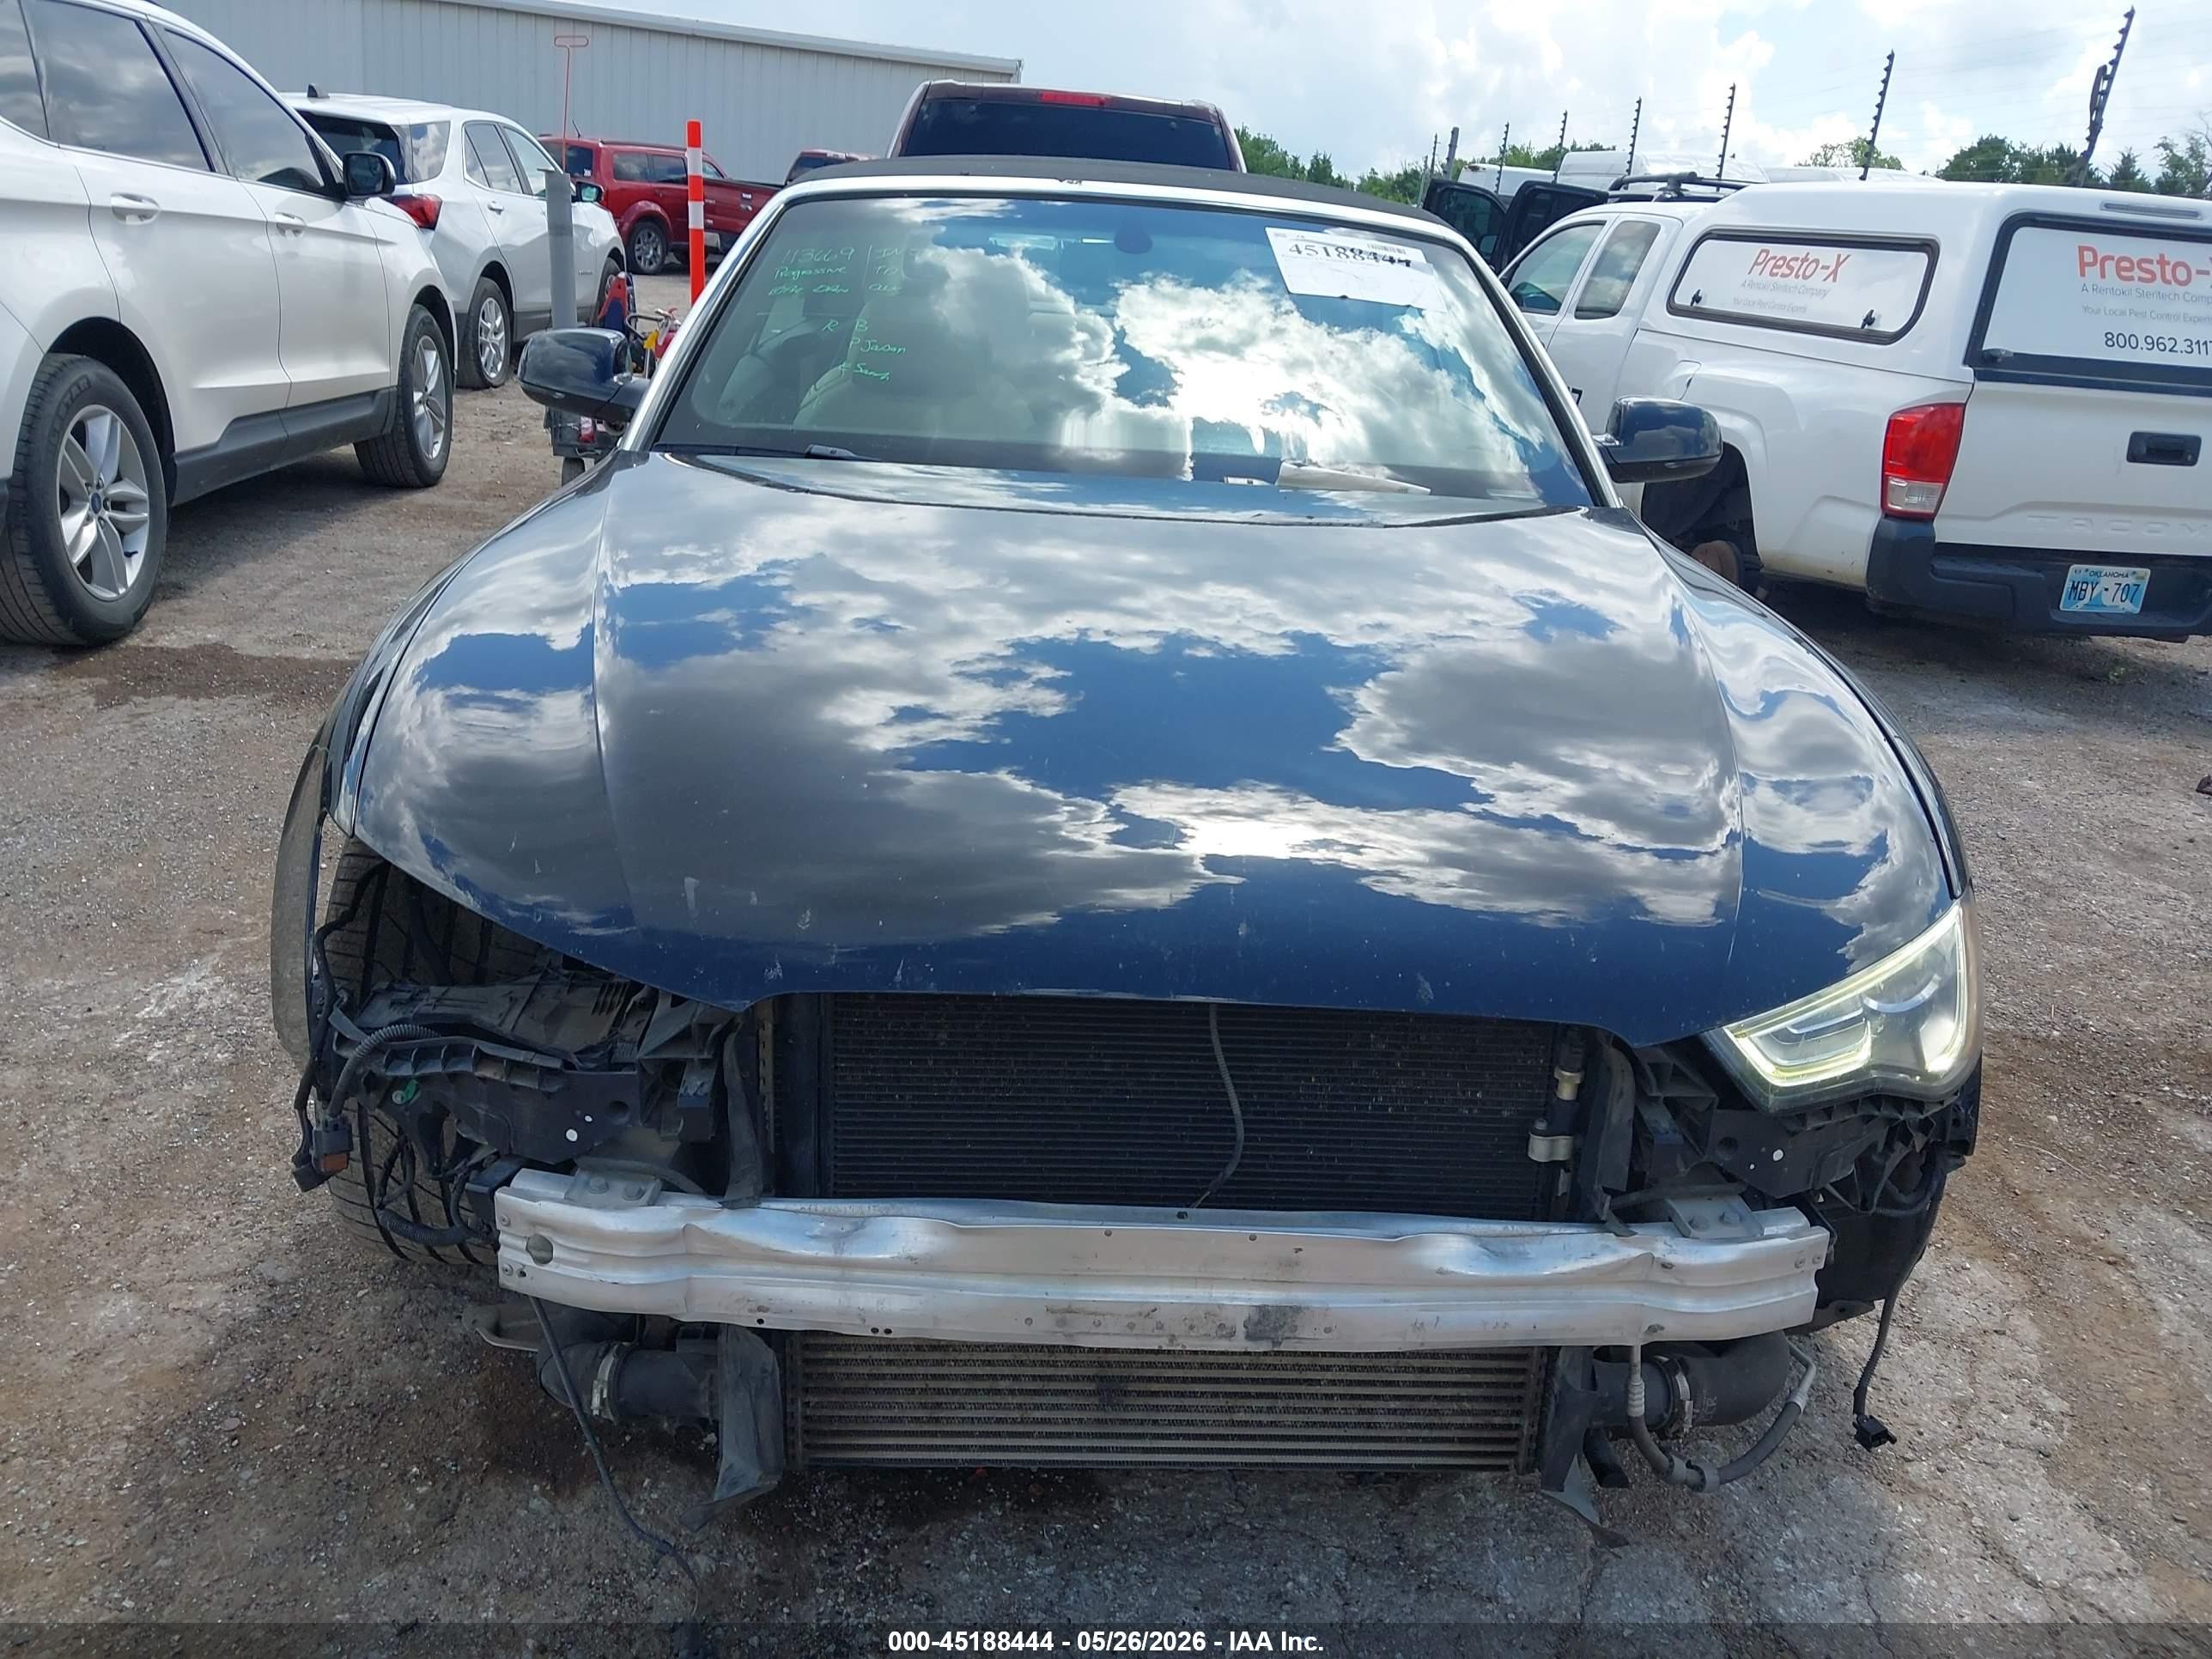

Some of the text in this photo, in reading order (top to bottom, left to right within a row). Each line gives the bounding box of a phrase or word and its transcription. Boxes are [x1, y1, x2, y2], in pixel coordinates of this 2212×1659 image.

[1747, 248, 1851, 283] Presto-X
[2078, 245, 2212, 289] Presto-
[2081, 283, 2089, 293] A
[2104, 331, 2212, 356] 800.962.311
[2088, 570, 2129, 579] OKLAHOMA
[2068, 580, 2141, 603] MBY 707
